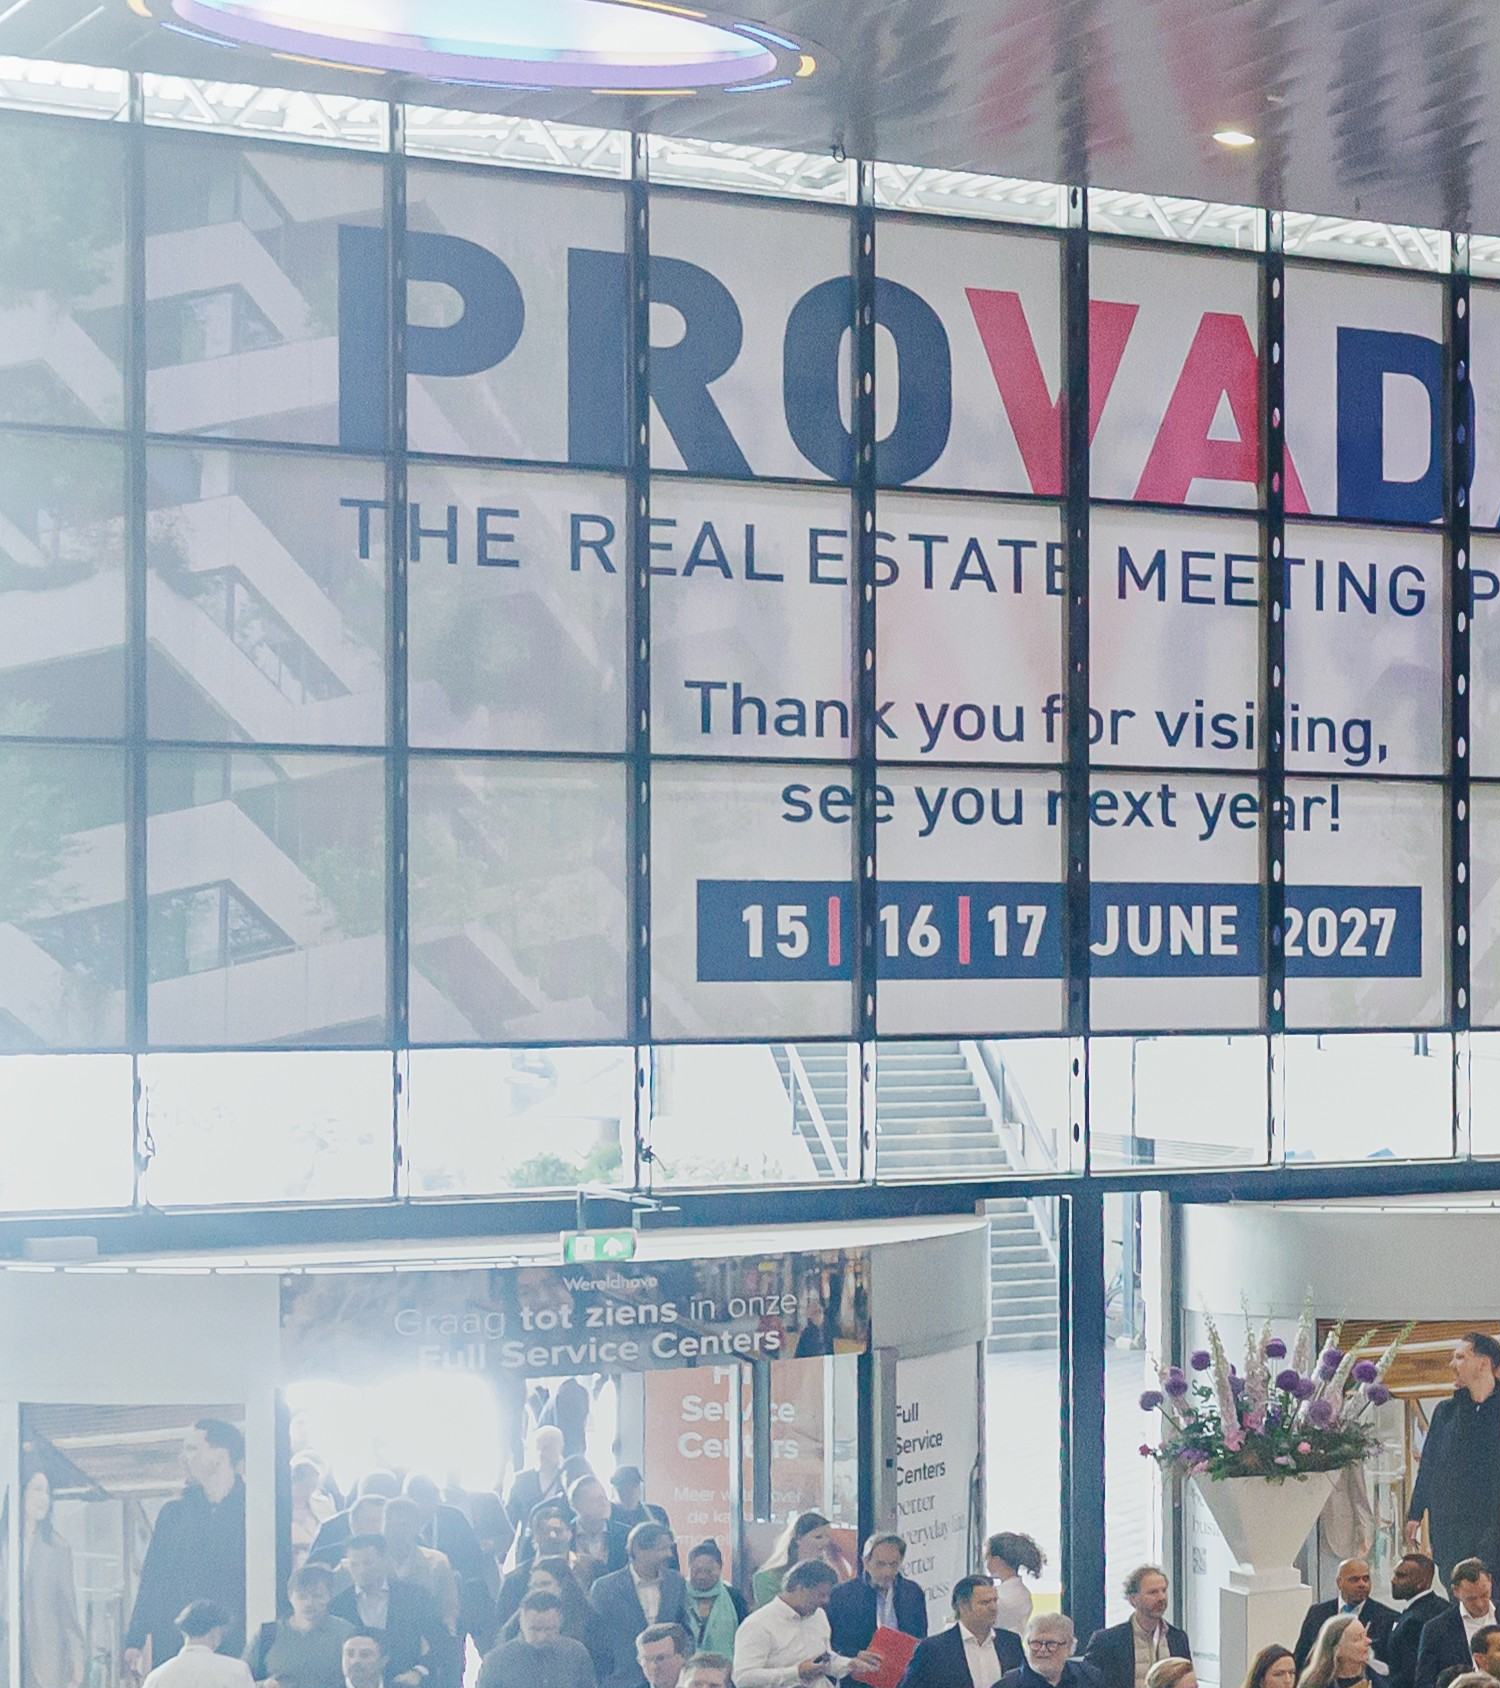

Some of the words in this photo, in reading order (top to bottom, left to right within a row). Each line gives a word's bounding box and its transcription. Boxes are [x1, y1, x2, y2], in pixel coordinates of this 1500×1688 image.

[340, 498, 520, 568] THE
[571, 513, 784, 582] REAL
[809, 528, 1067, 596] ESTATE
[1117, 546, 1426, 617] MEETING
[684, 680, 898, 740] Thank
[915, 702, 1024, 753] you
[1155, 699, 1387, 766] visiing,
[781, 784, 895, 824] see
[914, 786, 1023, 837] you
[1047, 784, 1177, 827] next
[742, 905, 809, 957] 15
[880, 905, 941, 957] 16
[987, 905, 1046, 957] 17
[1089, 905, 1238, 957] JUNE
[1284, 906, 1397, 958] 2027
[394, 1308, 505, 1339] Graag
[521, 1304, 573, 1332] tot
[585, 1302, 679, 1328] ziens
[690, 1296, 715, 1320] in
[728, 1293, 798, 1318] onze
[501, 1336, 639, 1368] Service
[651, 1327, 781, 1357] Centers
[681, 1395, 796, 1422] Sere
[678, 1432, 799, 1459] Cetrs
